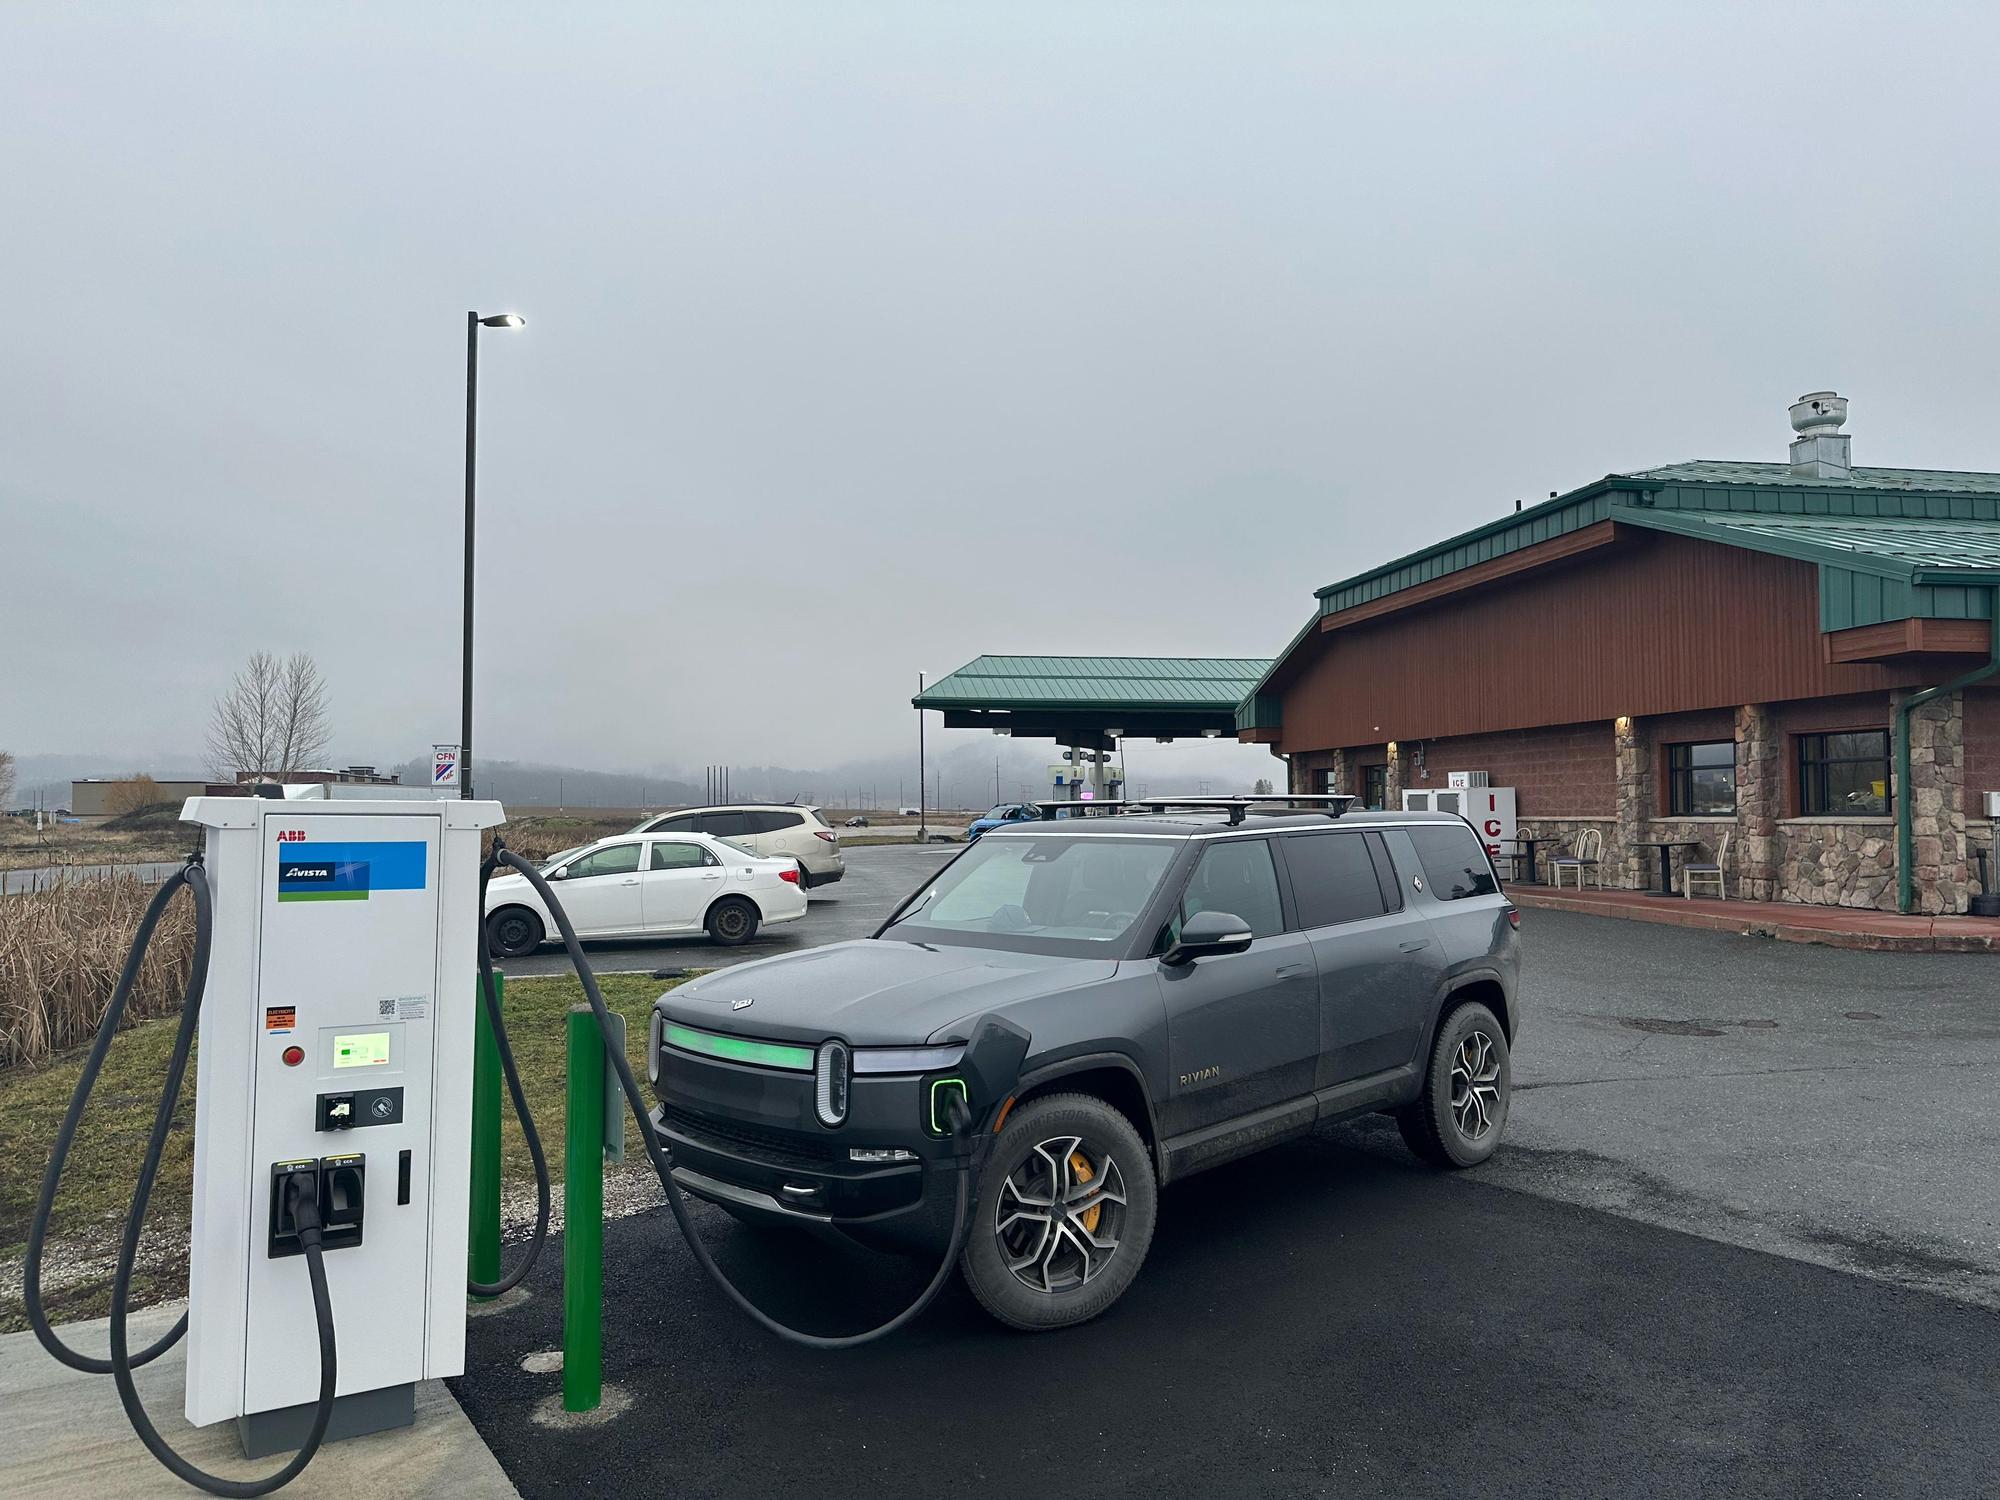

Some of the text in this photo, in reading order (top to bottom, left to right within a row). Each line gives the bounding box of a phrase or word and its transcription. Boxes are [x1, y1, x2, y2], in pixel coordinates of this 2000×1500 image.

[436, 753, 455, 761] CFN
[276, 830, 306, 841] ABB
[1484, 794, 1501, 862] ICE
[286, 868, 328, 877] AVISTA
[1180, 1066, 1220, 1086] RIVIAN
[1007, 1110, 1092, 1147] BRIDGESTONE
